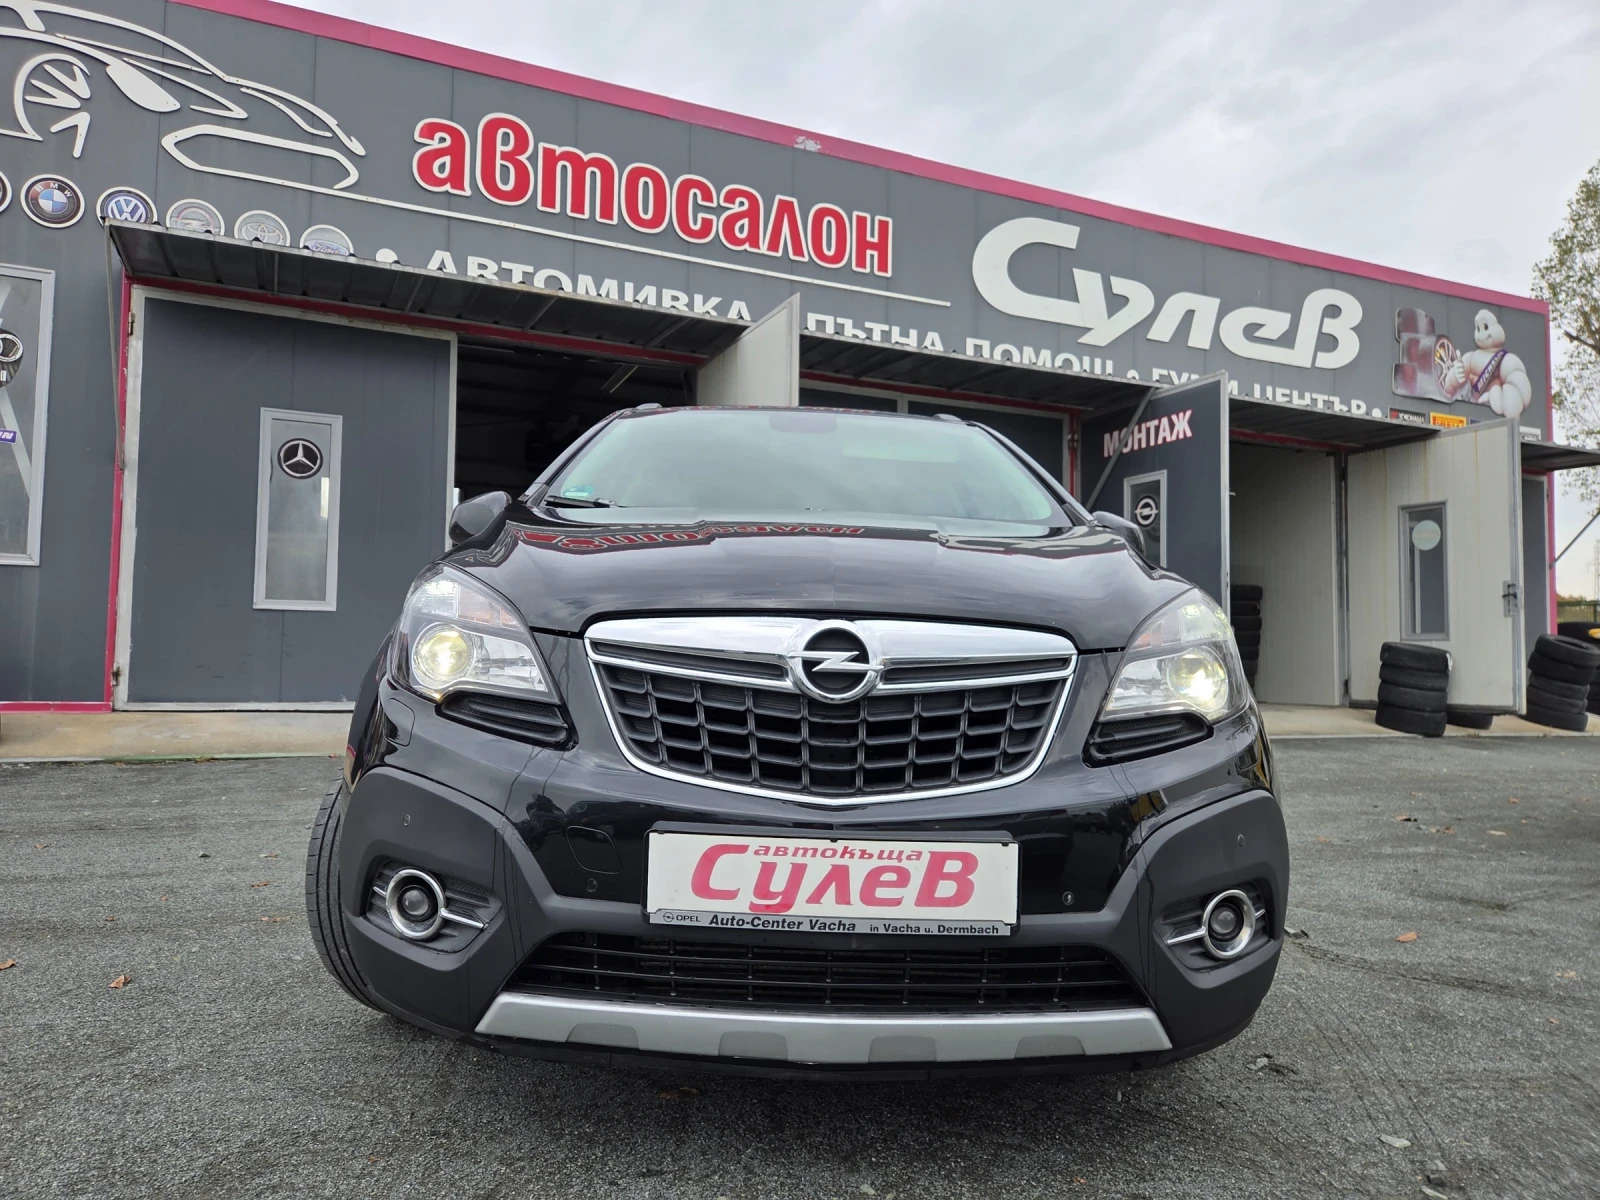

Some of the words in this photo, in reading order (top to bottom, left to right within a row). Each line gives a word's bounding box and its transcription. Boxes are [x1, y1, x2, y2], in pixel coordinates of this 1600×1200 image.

[34, 182, 73, 198] BMW
[413, 112, 892, 278] автосалон
[427, 249, 752, 322] АВТОМИВКА
[806, 312, 945, 352] ПЪТНА
[753, 844, 923, 864] автокъща
[675, 914, 702, 923] OPEL
[708, 914, 804, 931] Auto-Center
[809, 918, 857, 932] Vacha
[869, 924, 880, 933] in
[882, 923, 921, 934] Vacha
[924, 926, 934, 934] u.
[937, 924, 999, 935] Dermbach
